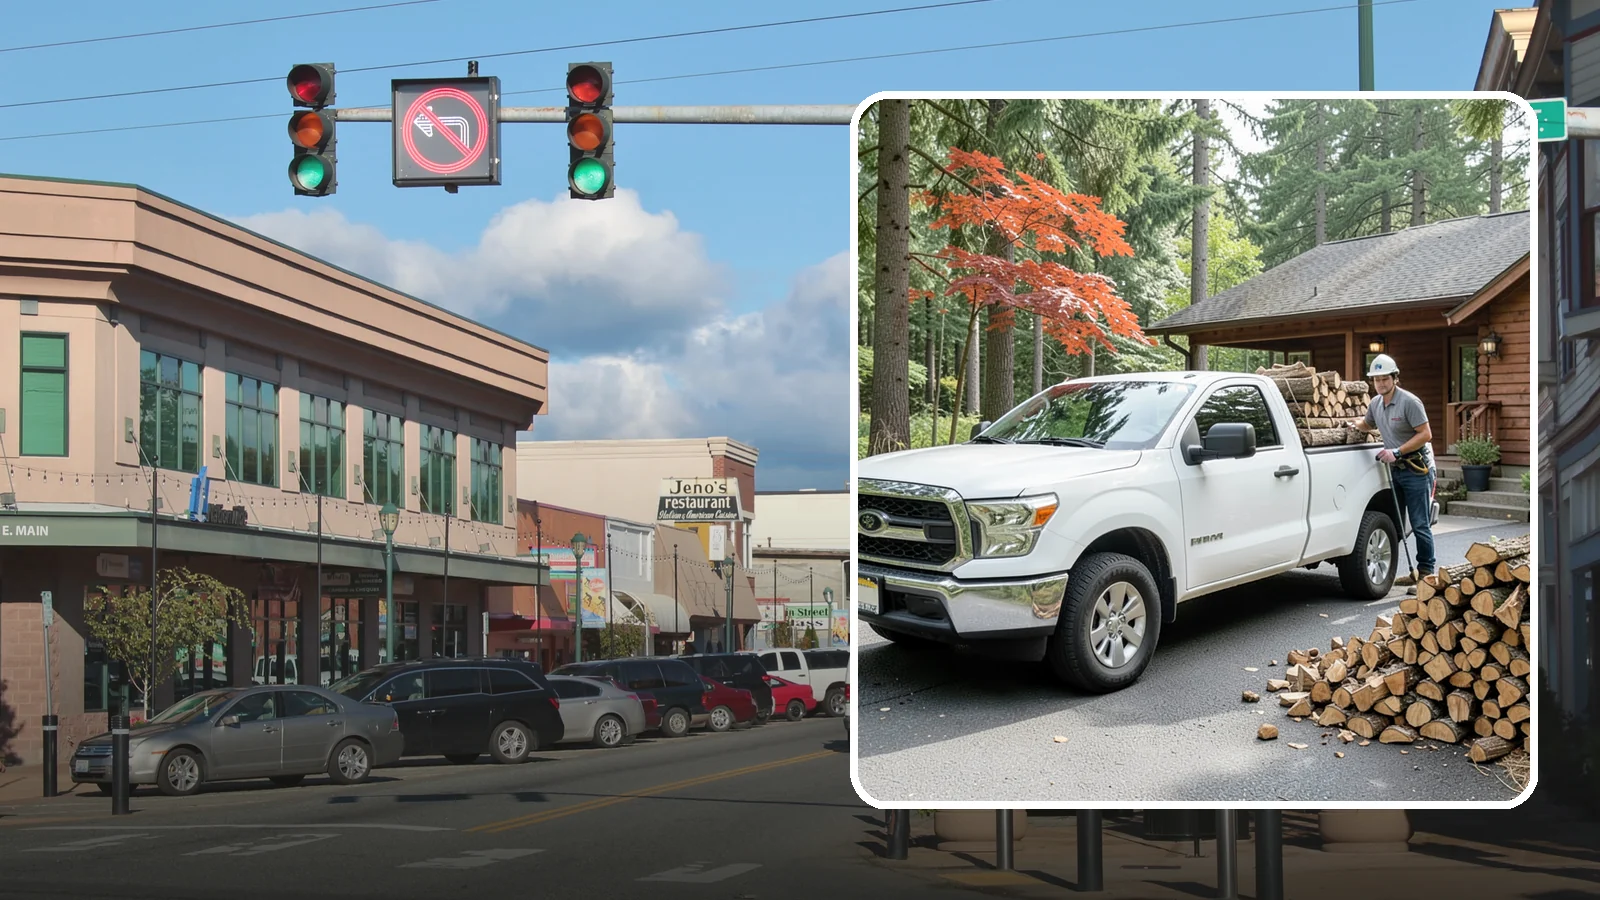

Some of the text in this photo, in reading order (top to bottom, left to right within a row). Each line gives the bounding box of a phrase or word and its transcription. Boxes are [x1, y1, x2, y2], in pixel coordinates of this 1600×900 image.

[669, 480, 728, 494] Jeno's
[665, 496, 731, 509] restaurant
[658, 509, 681, 519] Italian
[686, 509, 715, 519] American
[715, 509, 738, 519] Cuisine
[2, 525, 49, 536] E. MAIN
[797, 607, 828, 616] Street
